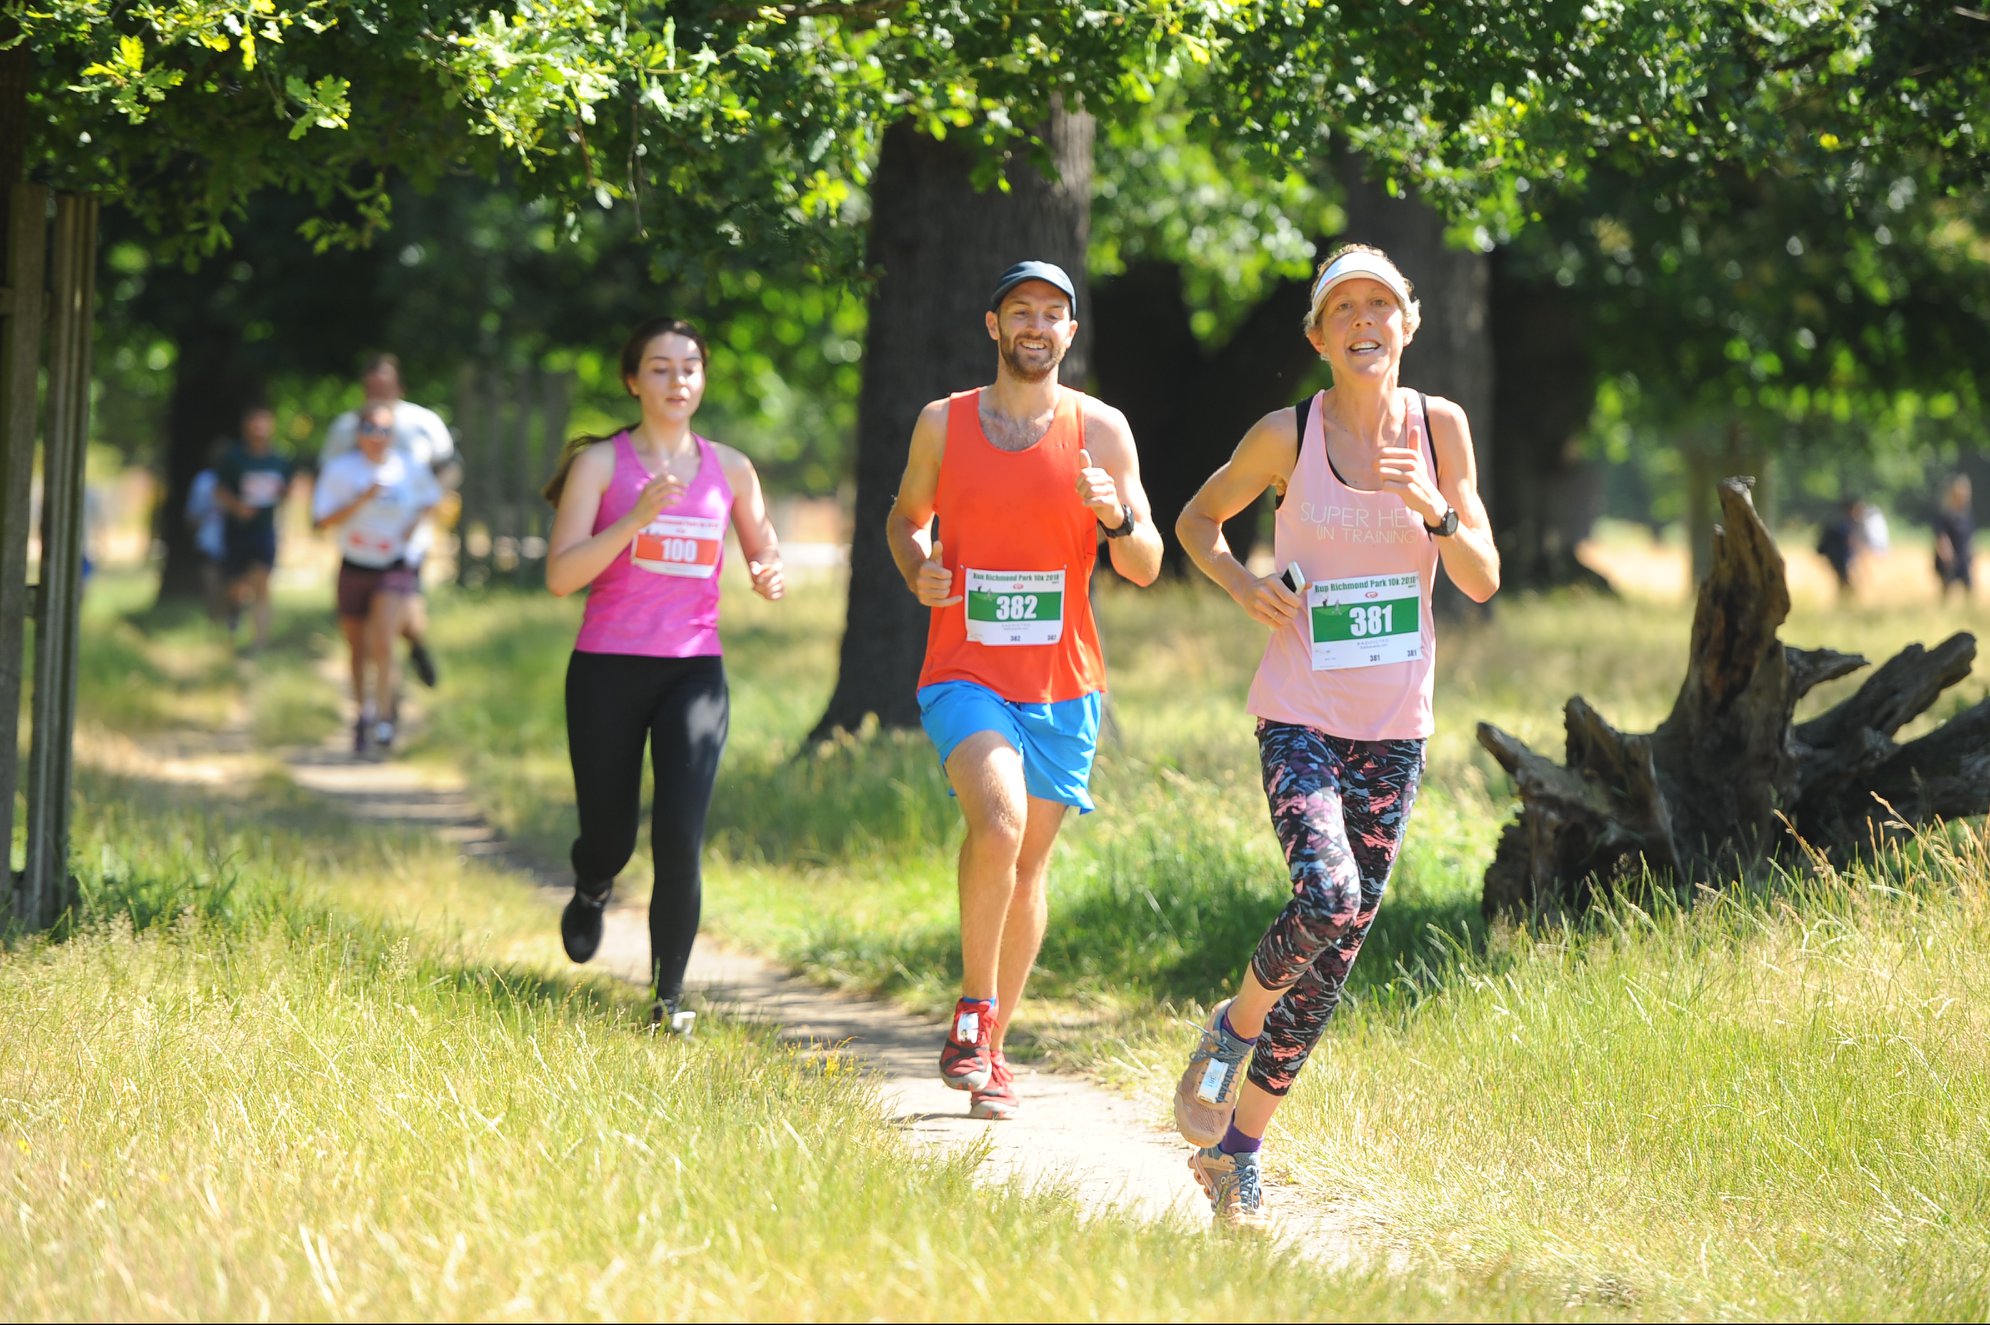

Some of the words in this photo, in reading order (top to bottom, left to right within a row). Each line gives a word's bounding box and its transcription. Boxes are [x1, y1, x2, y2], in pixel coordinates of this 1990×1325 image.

[1300, 501, 1369, 528] SUPER
[661, 538, 698, 562] 100
[985, 573, 1017, 582] Richmond
[1018, 573, 1032, 581] Park
[1330, 579, 1369, 591] Richmond
[1370, 578, 1387, 588] Park
[1388, 577, 1400, 587] 10k
[996, 595, 1038, 620] 382
[1349, 604, 1393, 637] 381
[1369, 653, 1381, 662] 381
[1407, 648, 1418, 657] 381
